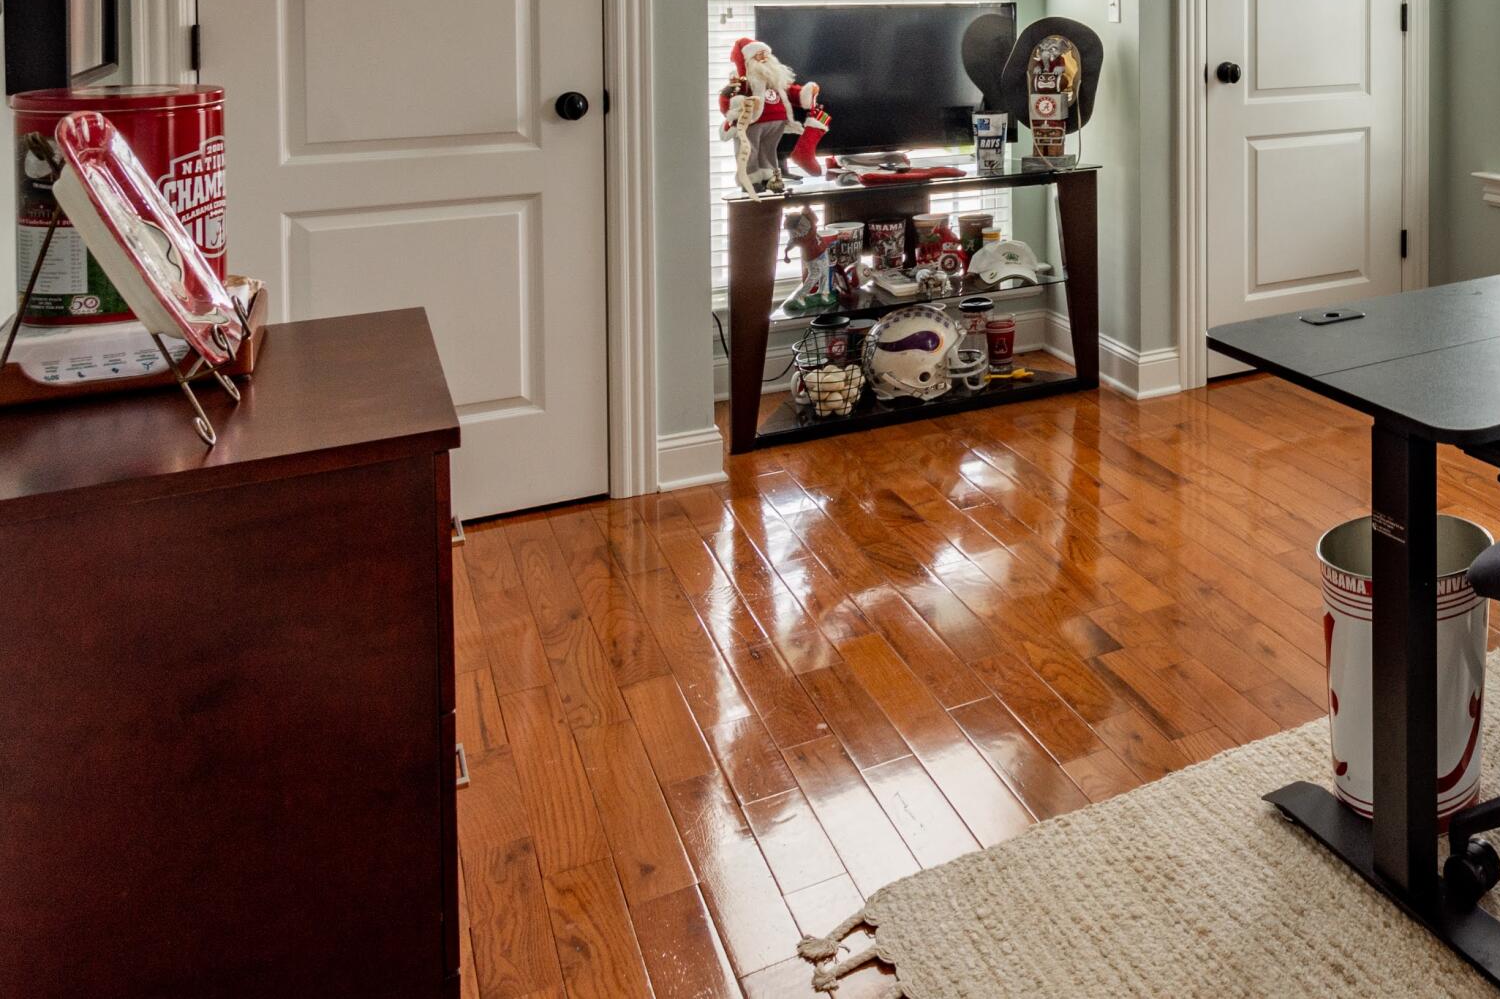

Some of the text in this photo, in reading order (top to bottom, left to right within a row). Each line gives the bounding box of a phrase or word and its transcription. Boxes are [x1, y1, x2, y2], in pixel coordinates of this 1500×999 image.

[980, 138, 1000, 149] RAYS
[70, 296, 98, 310] 50
[1321, 563, 1368, 595] ALABAMA
